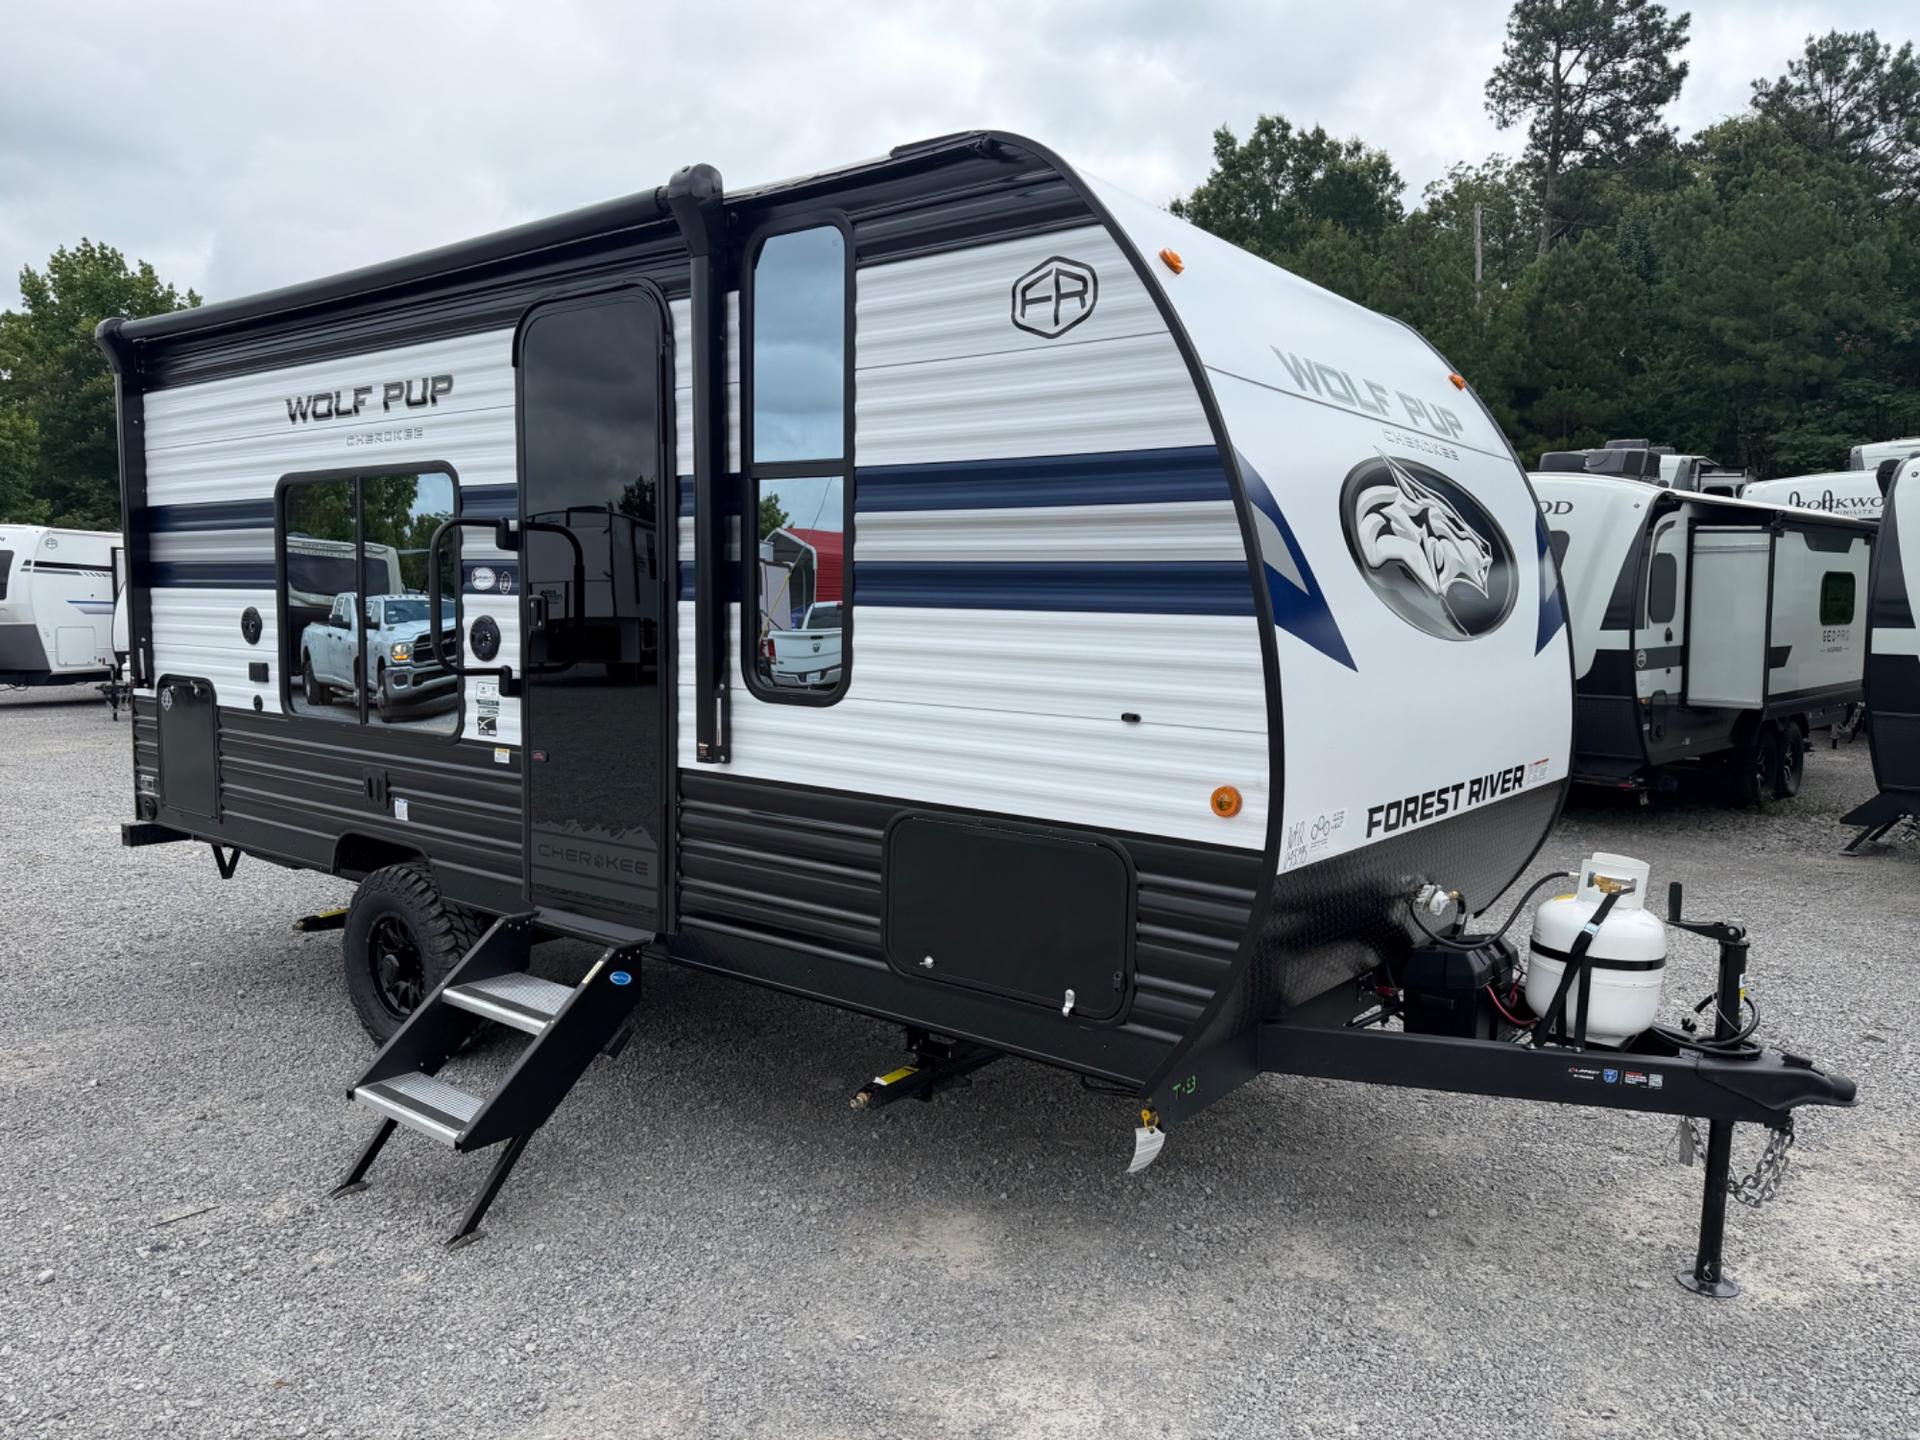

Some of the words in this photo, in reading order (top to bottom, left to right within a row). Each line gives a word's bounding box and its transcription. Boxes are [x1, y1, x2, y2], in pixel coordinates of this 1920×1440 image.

[285, 386, 373, 425] WOLF
[383, 374, 454, 413] PUP
[1269, 345, 1390, 417] WOLF
[1395, 390, 1464, 439] PUP
[346, 427, 424, 446] CHEROKEE
[1384, 430, 1459, 461] CHEROKEE
[1366, 782, 1465, 839] FOREST
[1468, 764, 1526, 806] RIVER
